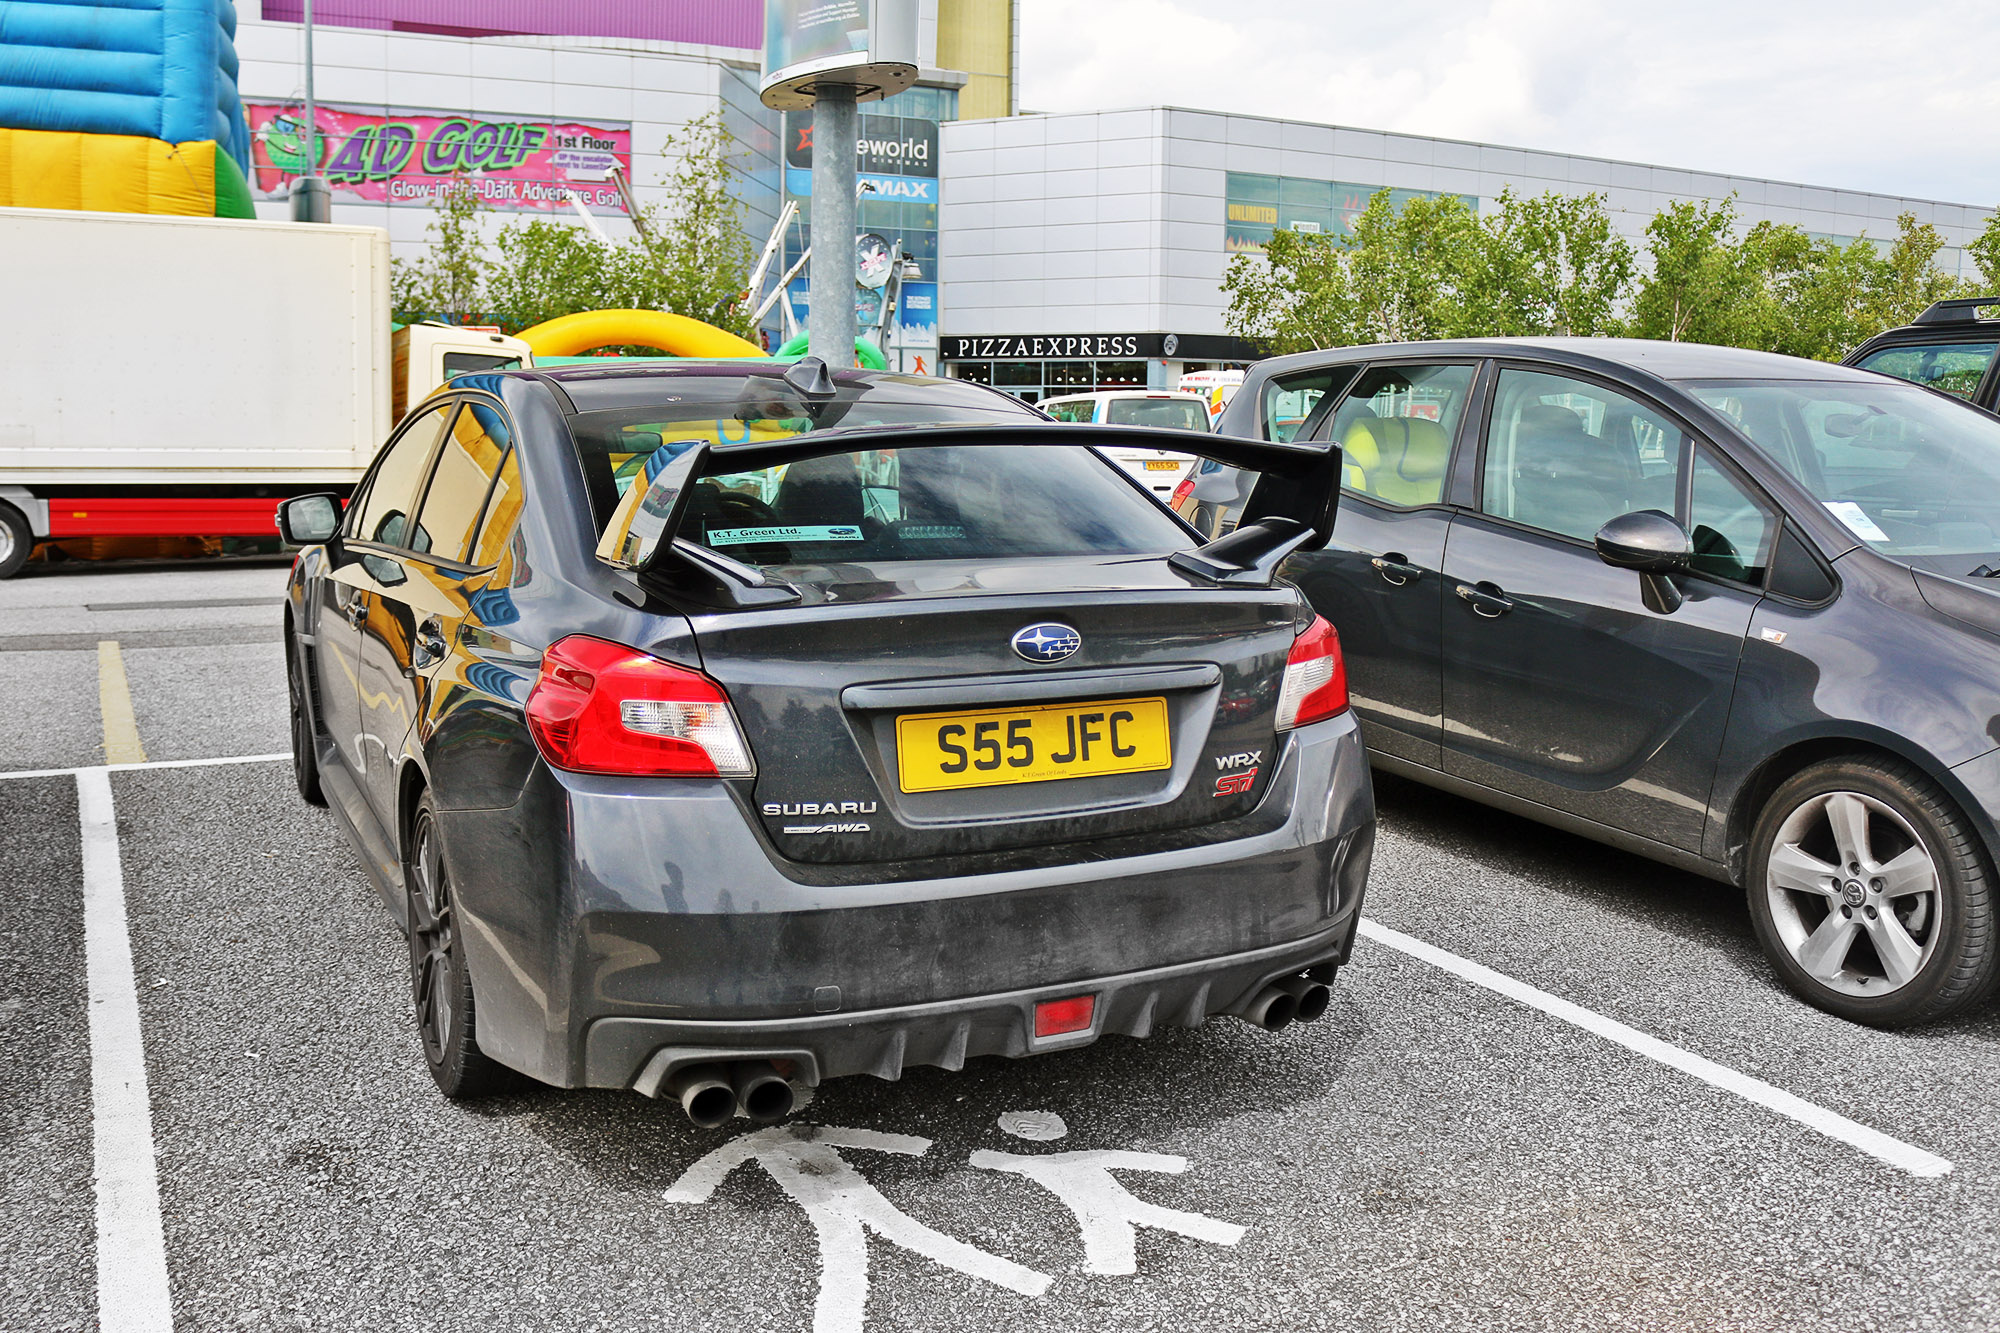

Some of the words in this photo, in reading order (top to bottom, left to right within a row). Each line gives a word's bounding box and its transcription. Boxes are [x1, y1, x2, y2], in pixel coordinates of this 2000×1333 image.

[324, 122, 417, 182] 4D
[423, 119, 548, 174] GOLF
[556, 135, 577, 148] 1st
[582, 136, 616, 150] Floor
[856, 137, 929, 160] eworld
[871, 157, 928, 168] CINEMAS
[1228, 203, 1278, 224] UNLIMITED
[958, 337, 1138, 357] PIZZAEXPRESS
[713, 530, 737, 538] K.T.
[740, 529, 776, 537] Green
[779, 527, 801, 535] Ltd.
[937, 718, 1034, 774] S55
[1050, 710, 1137, 765] JFC
[1215, 750, 1263, 770] WRX
[762, 801, 877, 816] SUBARU
[816, 823, 871, 834] AWD
